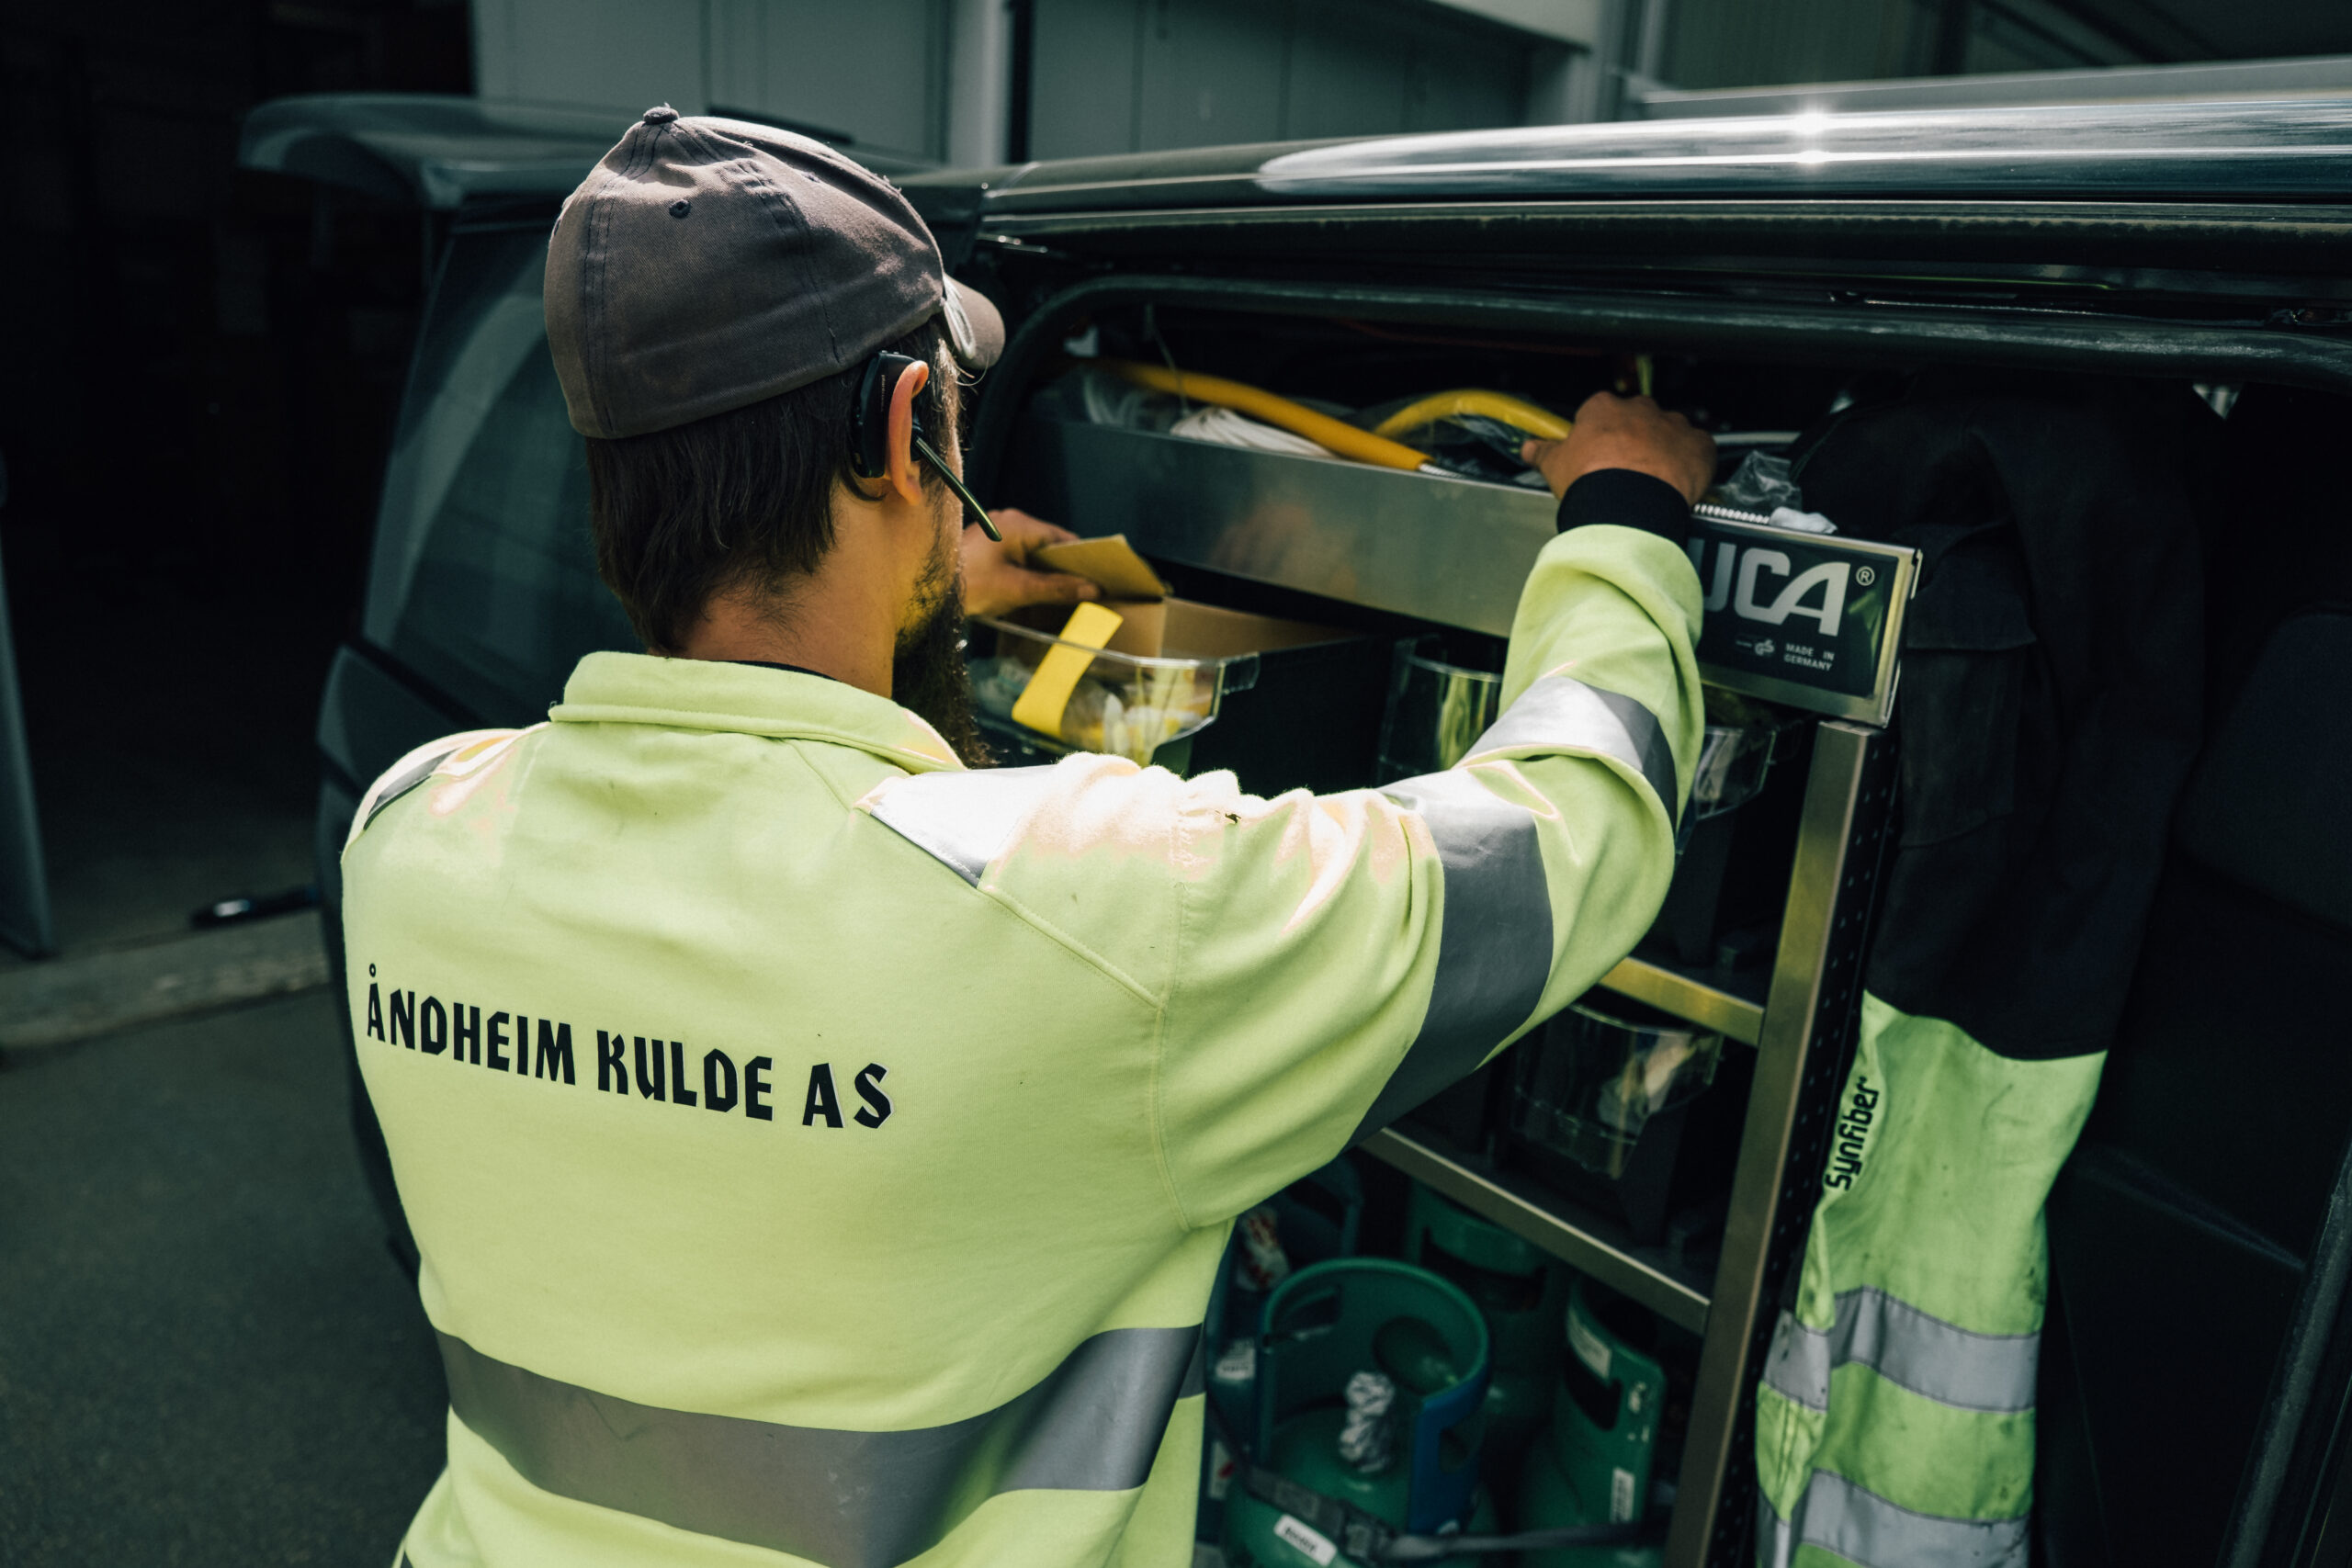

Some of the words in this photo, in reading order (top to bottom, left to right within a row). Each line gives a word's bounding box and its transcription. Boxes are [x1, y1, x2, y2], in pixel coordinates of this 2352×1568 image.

[1785, 643, 1815, 657] MADE
[1823, 651, 1835, 660] IN
[1783, 654, 1832, 671] GERMANY
[368, 964, 576, 1086] ÅNDHEIM
[596, 1030, 774, 1122] KULDE
[802, 1063, 895, 1129] AS
